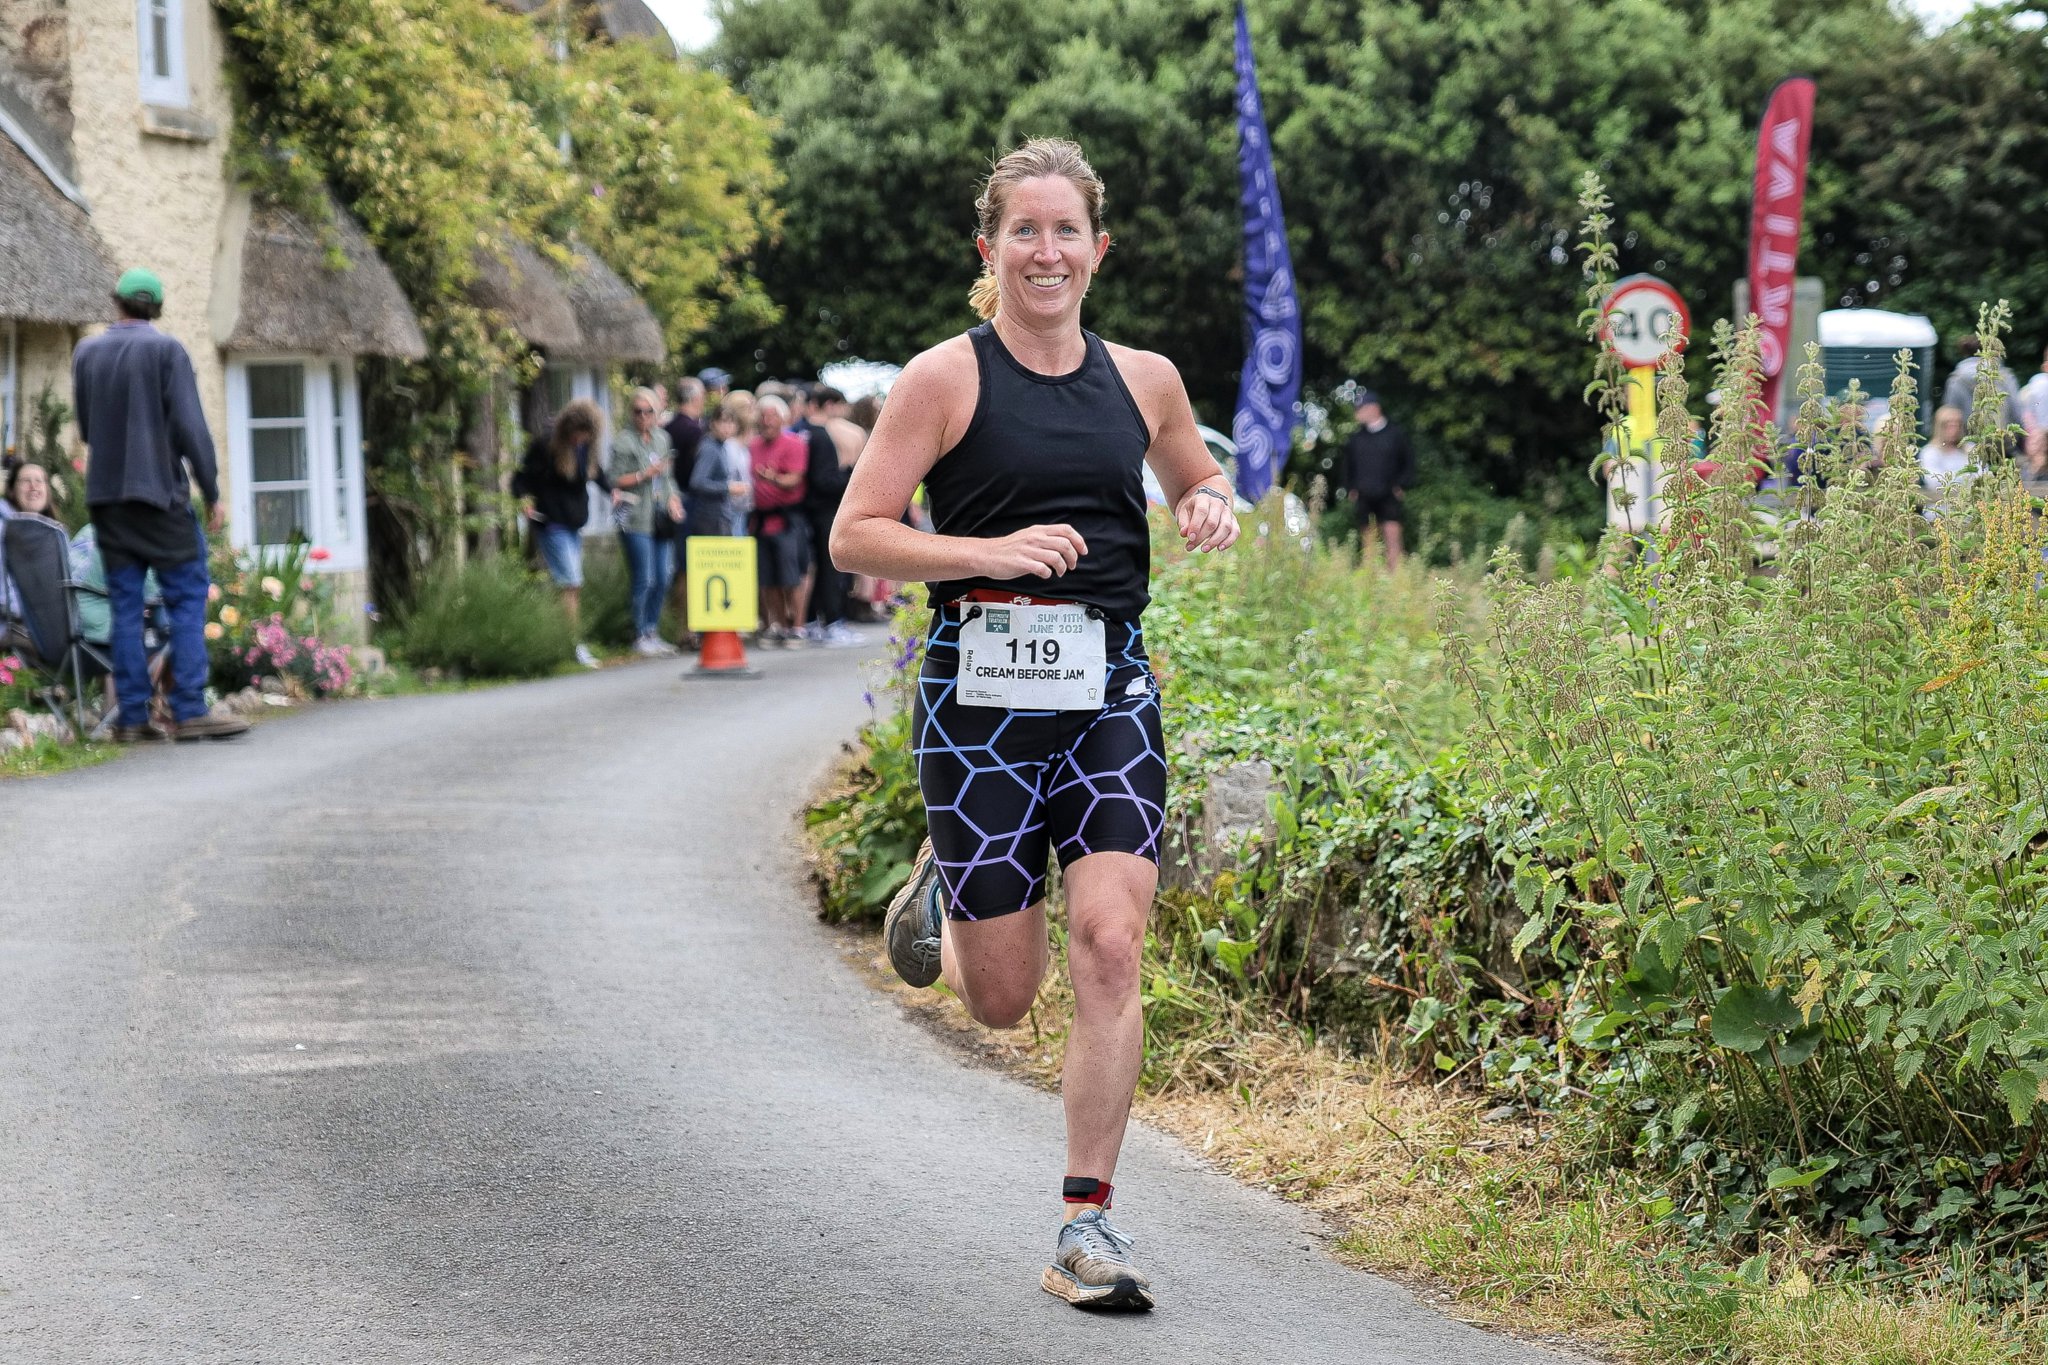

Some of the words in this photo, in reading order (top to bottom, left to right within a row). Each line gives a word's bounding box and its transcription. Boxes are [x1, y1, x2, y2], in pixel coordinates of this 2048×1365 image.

[1613, 307, 1673, 344] 40
[1037, 613, 1058, 623] SUN
[1062, 613, 1084, 623] 11TH
[1027, 624, 1054, 634] JUNE
[1058, 625, 1083, 634] 2023
[965, 649, 974, 672] Relay
[1005, 638, 1060, 665] 119
[976, 666, 1015, 679] CREAM
[1017, 668, 1062, 680] BEFORE
[1063, 669, 1085, 680] JAM
